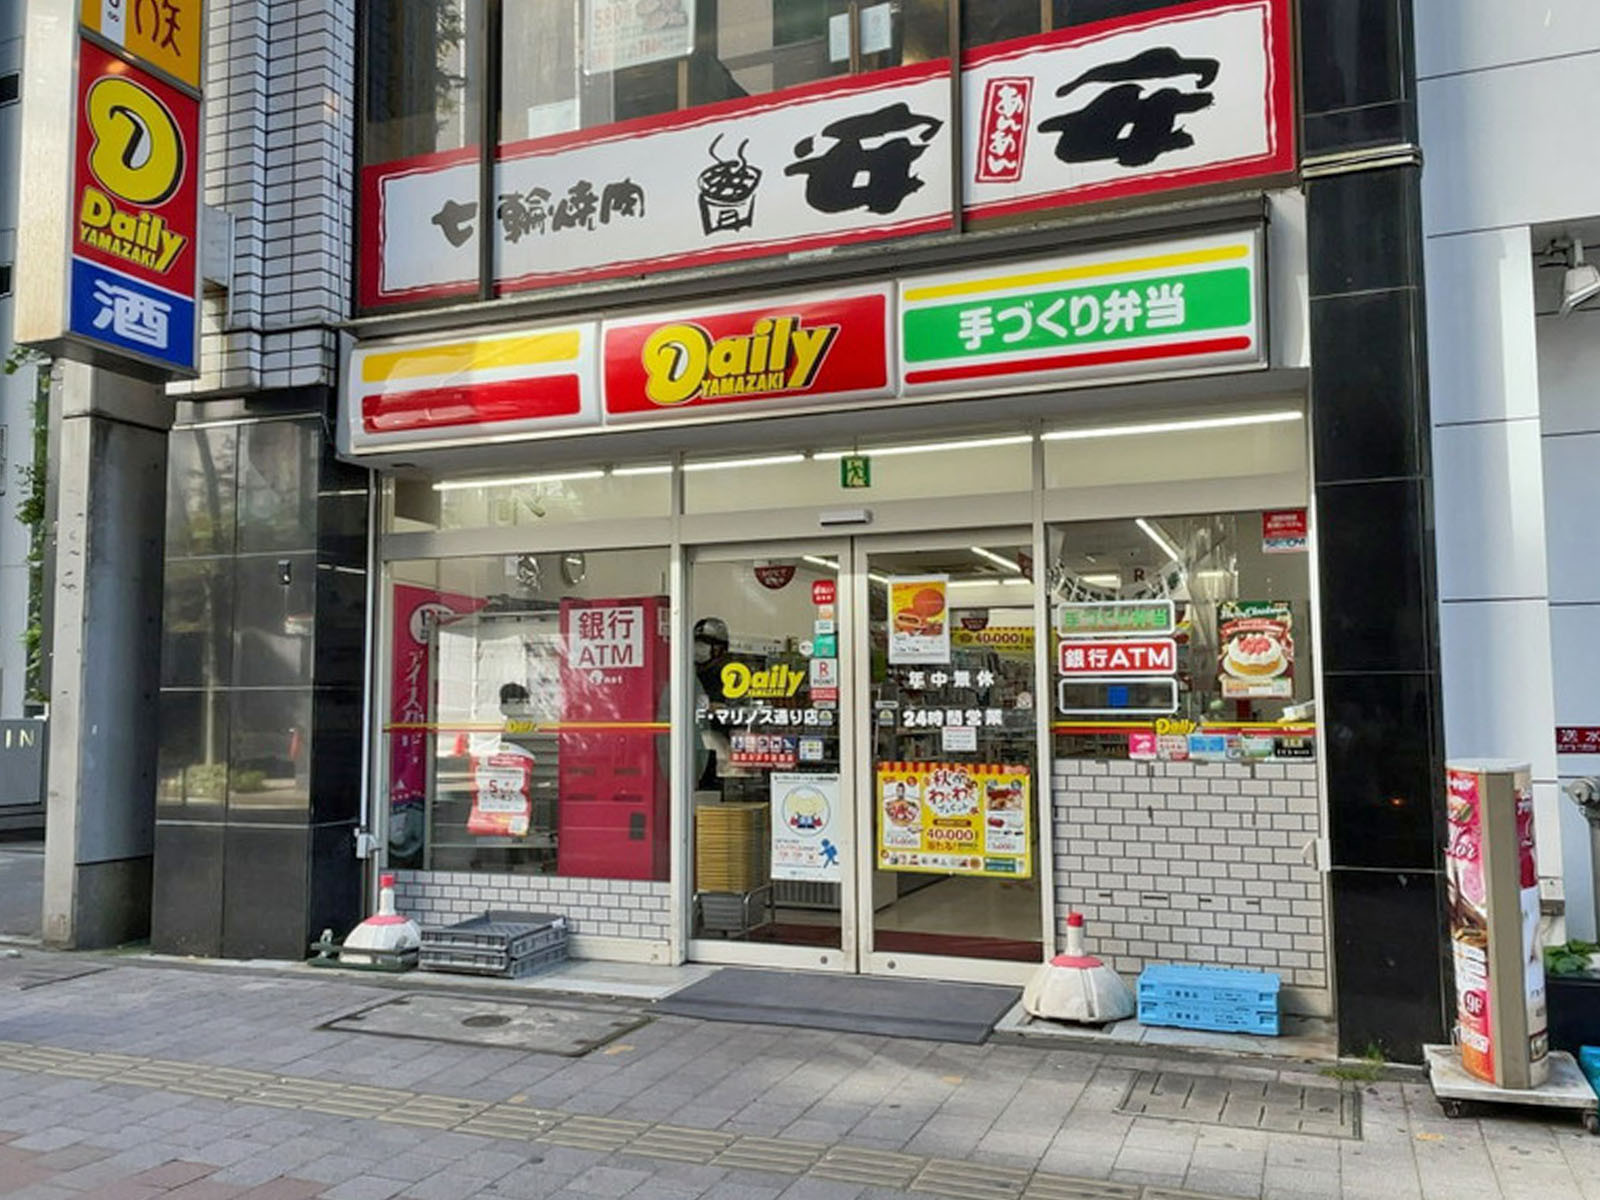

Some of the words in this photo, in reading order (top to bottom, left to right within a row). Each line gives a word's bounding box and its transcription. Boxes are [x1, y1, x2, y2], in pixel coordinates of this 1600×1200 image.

[987, 84, 1023, 174] あんあん
[80, 222, 157, 269] YAMAZAKI
[81, 185, 189, 274] Daily
[93, 279, 172, 349] 酒
[957, 282, 1187, 351] 手づくり弁当
[641, 314, 841, 405] Daily
[701, 372, 785, 398] YAMAZAKI
[578, 610, 635, 640] 銀行
[579, 644, 633, 666] ATM
[1064, 647, 1170, 669] 銀行ATM
[721, 662, 806, 699] Daily
[908, 670, 995, 690] 年中無休
[902, 708, 1003, 727] 24時間営業
